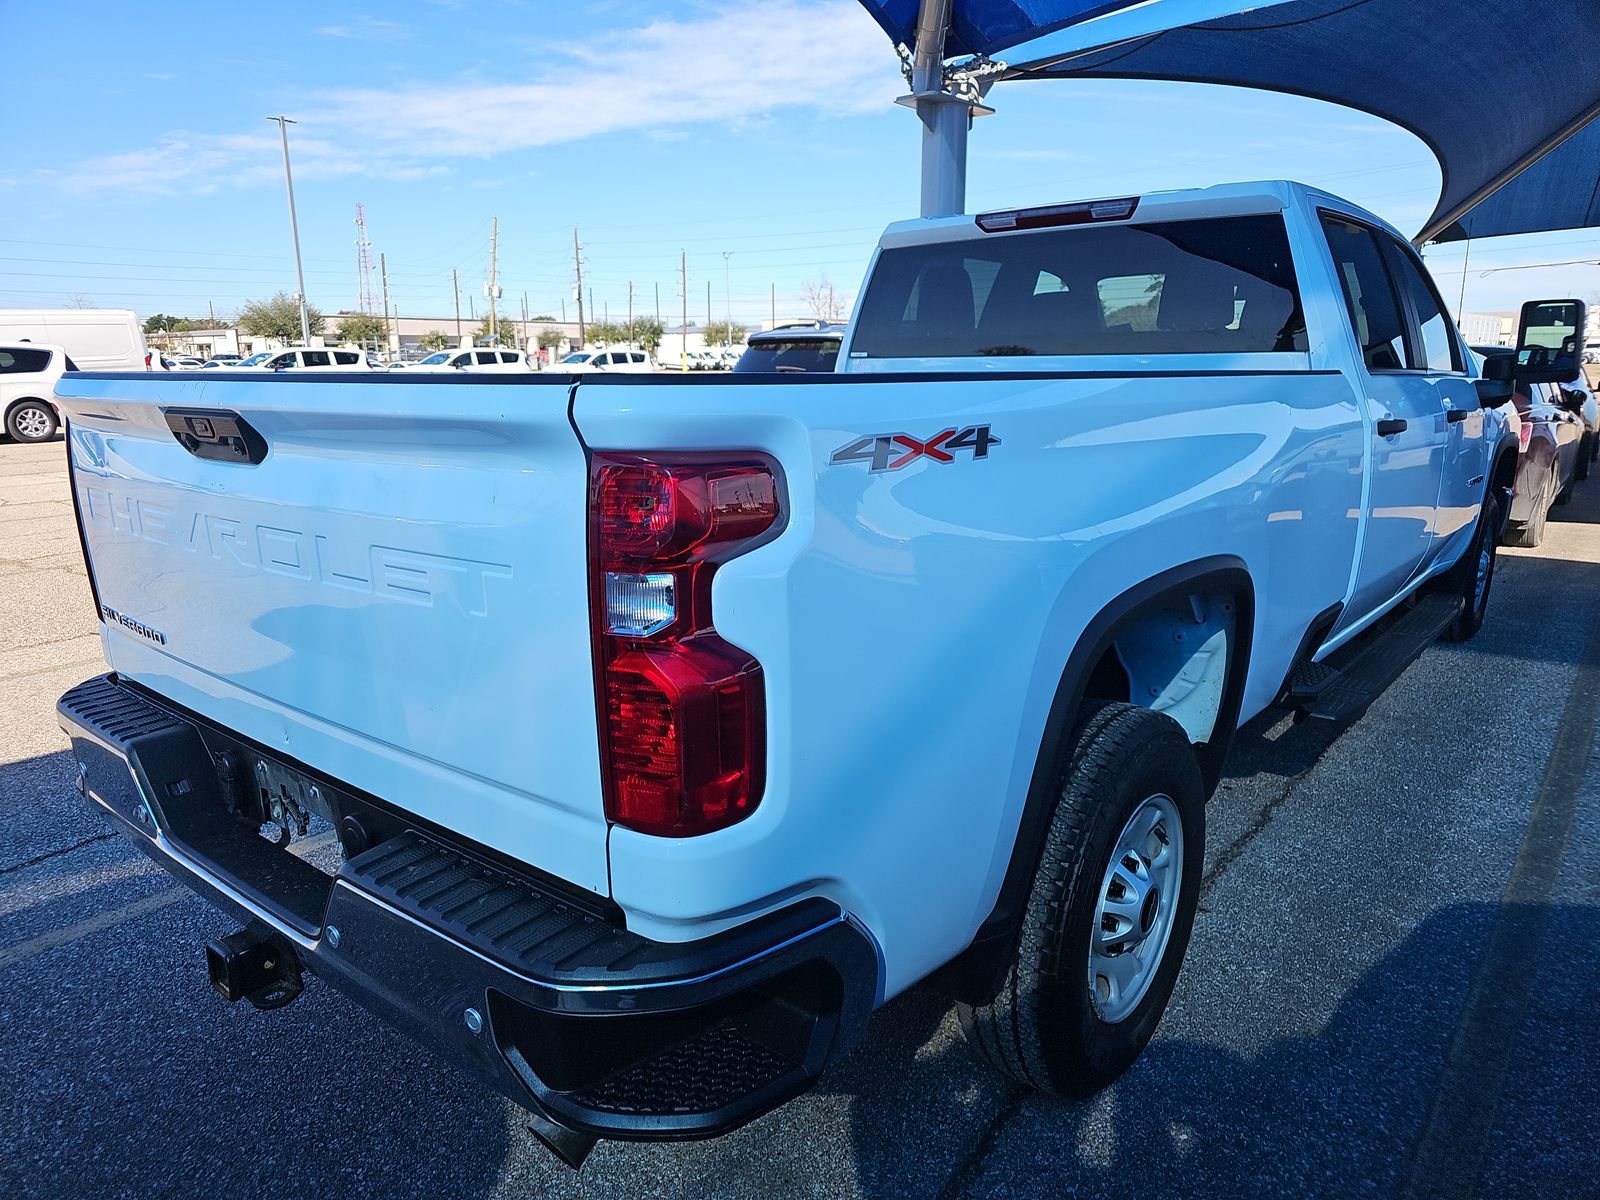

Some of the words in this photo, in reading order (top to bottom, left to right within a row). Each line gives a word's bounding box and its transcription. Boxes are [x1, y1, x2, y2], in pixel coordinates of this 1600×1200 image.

[829, 423, 1002, 475] 4X4
[86, 486, 514, 618] CHEVROLET
[101, 604, 167, 645] SILVERADO
